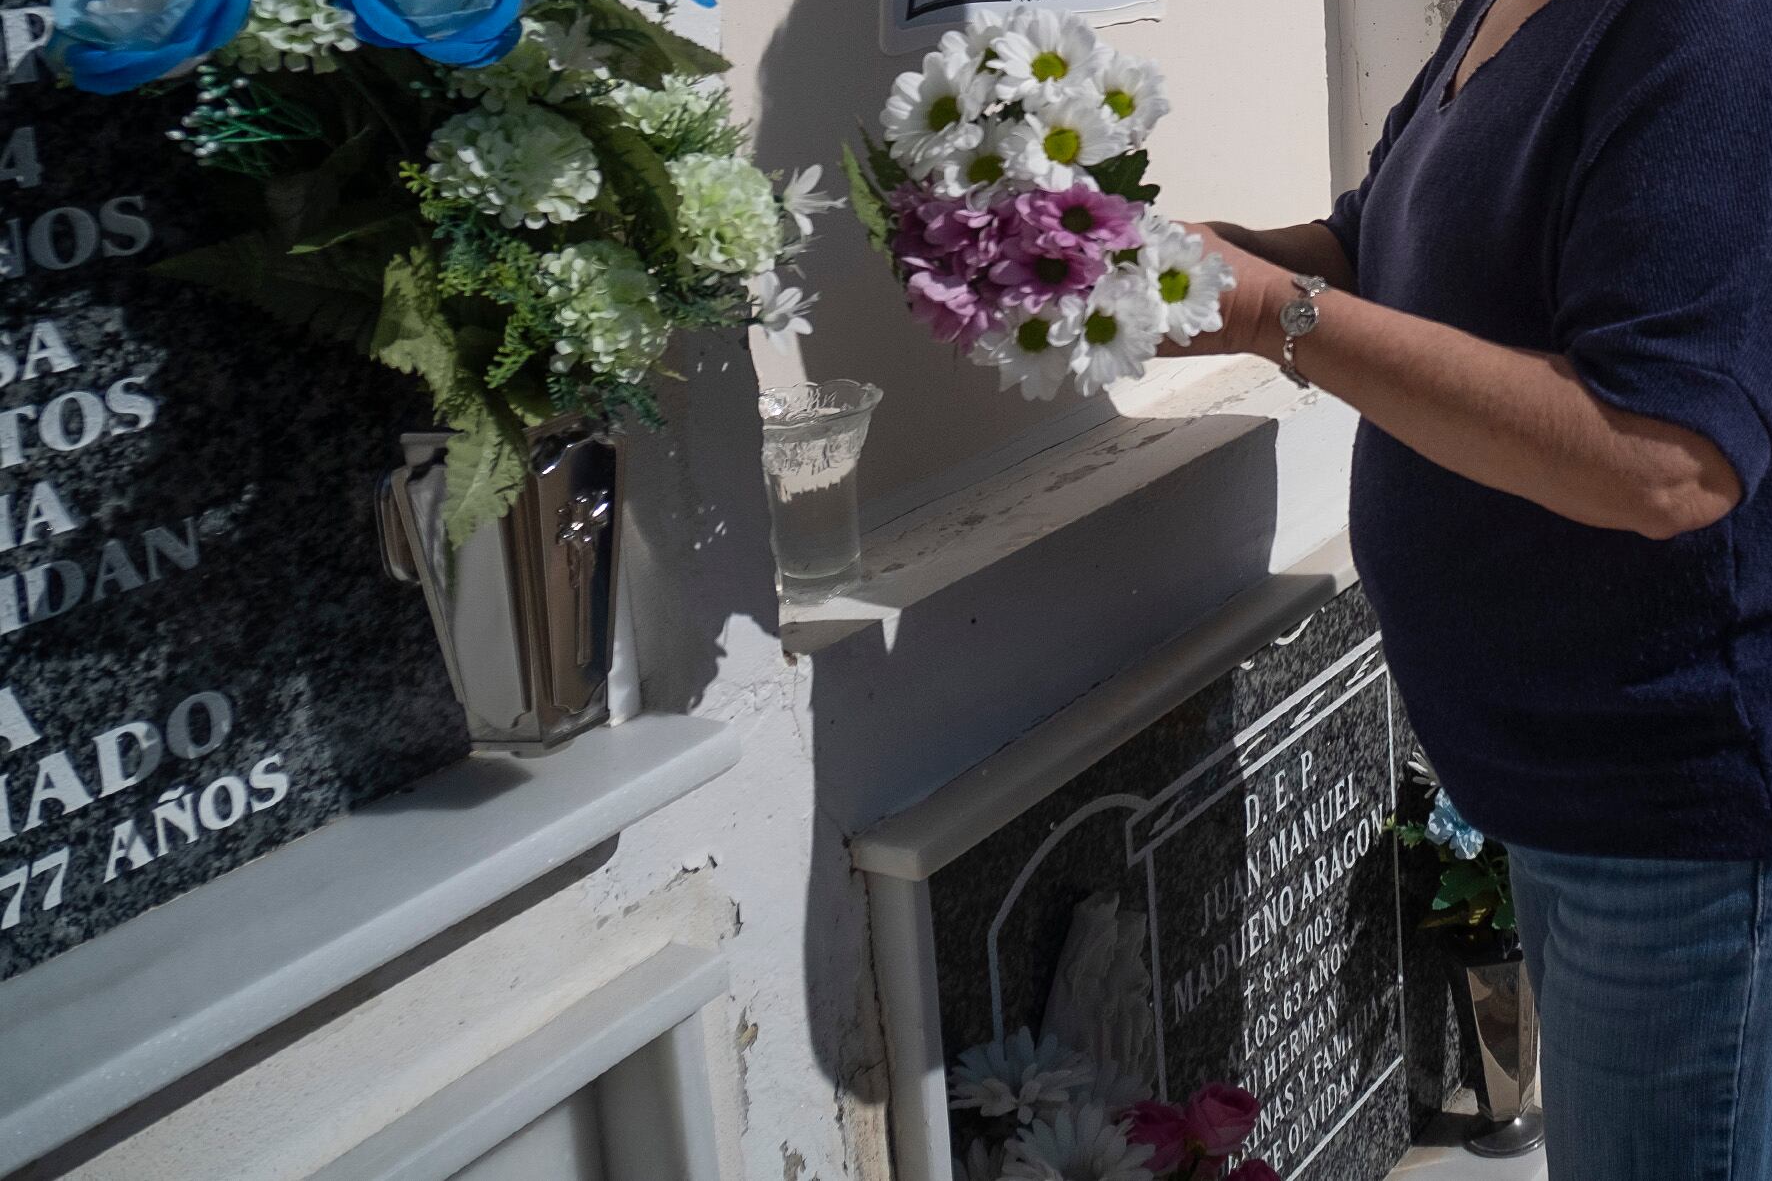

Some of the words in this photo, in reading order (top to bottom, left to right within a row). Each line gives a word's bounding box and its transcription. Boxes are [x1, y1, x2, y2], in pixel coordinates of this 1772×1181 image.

[103, 754, 289, 884] AÑOS
[1269, 772, 1360, 878] MANUEL
[1174, 885, 1294, 1025] MADUEÑO
[1301, 803, 1383, 911] ARAGON
[1243, 1003, 1278, 1061] LOS
[1283, 981, 1302, 1021] 63
[1288, 1058, 1359, 1155] OLVIDAN
